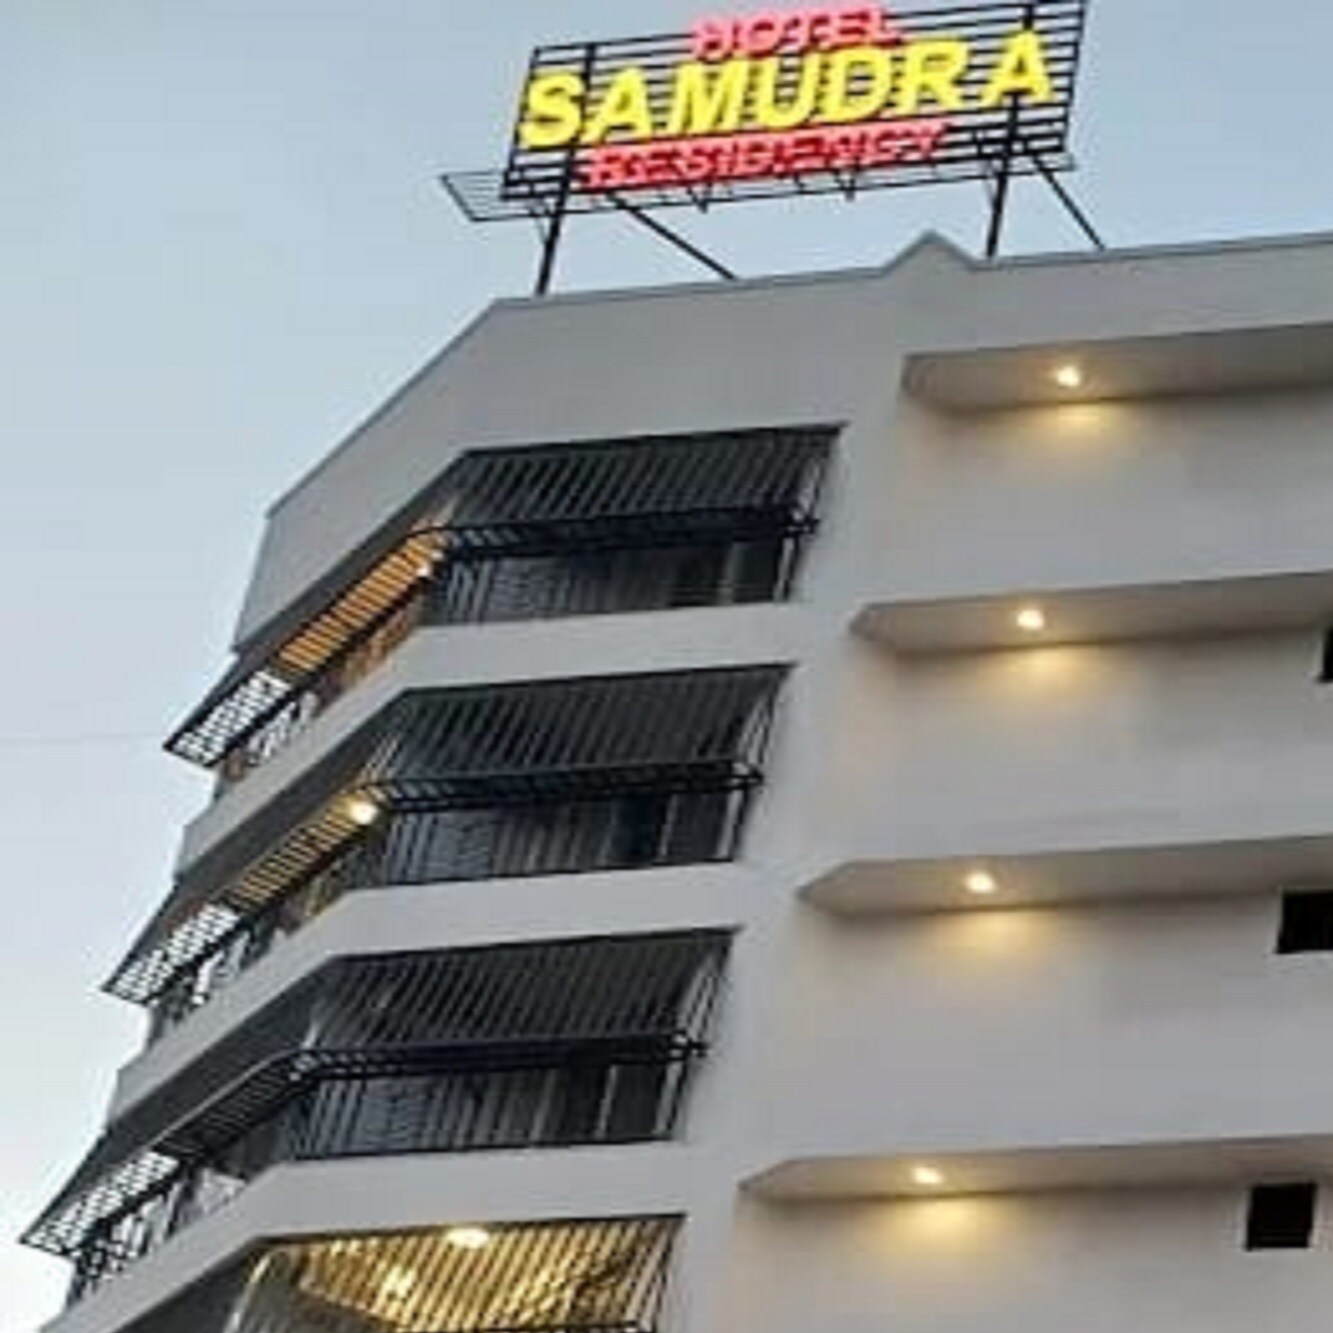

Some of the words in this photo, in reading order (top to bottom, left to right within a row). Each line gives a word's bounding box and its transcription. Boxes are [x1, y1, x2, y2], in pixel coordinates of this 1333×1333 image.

[692, 3, 902, 62] HOTEL
[518, 27, 1055, 149] SAMUDRA
[582, 118, 950, 191] RESIDENCY
